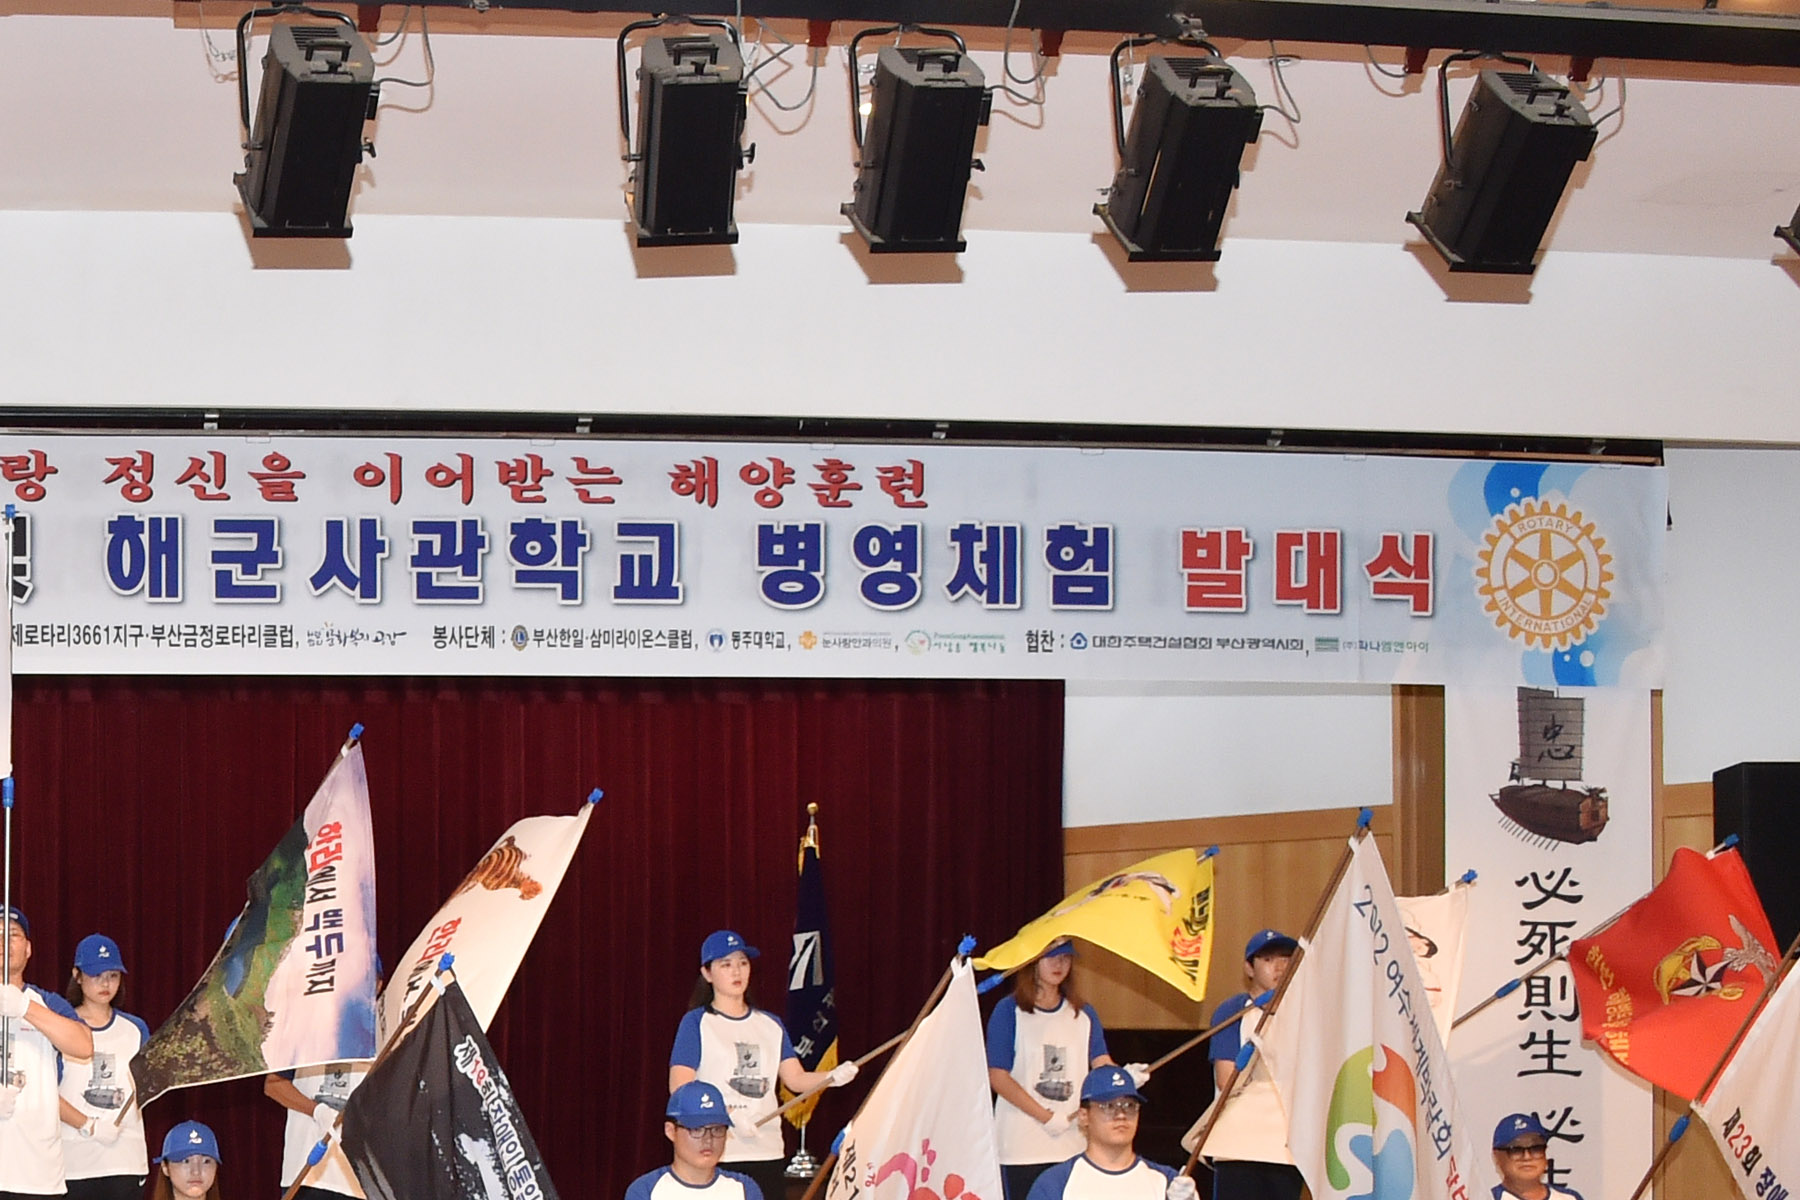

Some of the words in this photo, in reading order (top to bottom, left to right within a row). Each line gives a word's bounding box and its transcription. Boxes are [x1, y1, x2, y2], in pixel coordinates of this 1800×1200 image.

[102, 449, 307, 503] 정신을
[353, 452, 625, 507] 이어받는
[668, 456, 929, 510] 해양훈련
[1517, 517, 1574, 534] ROTARY
[104, 512, 685, 607] 해군사관학교
[755, 520, 1117, 612] 병영체험
[1179, 526, 1434, 616] 발대식
[432, 625, 496, 650] 봉사단체
[1025, 629, 1056, 654] 협찬
[1092, 636, 1213, 650] 대한주택건설협회
[1498, 597, 1592, 633] INTERNATIONAL
[1539, 713, 1574, 764] 忠
[306, 820, 343, 905] 한라에서
[302, 907, 345, 997] 백두까지
[1352, 883, 1387, 968] 2012
[1720, 1106, 1762, 1176] 제23회
